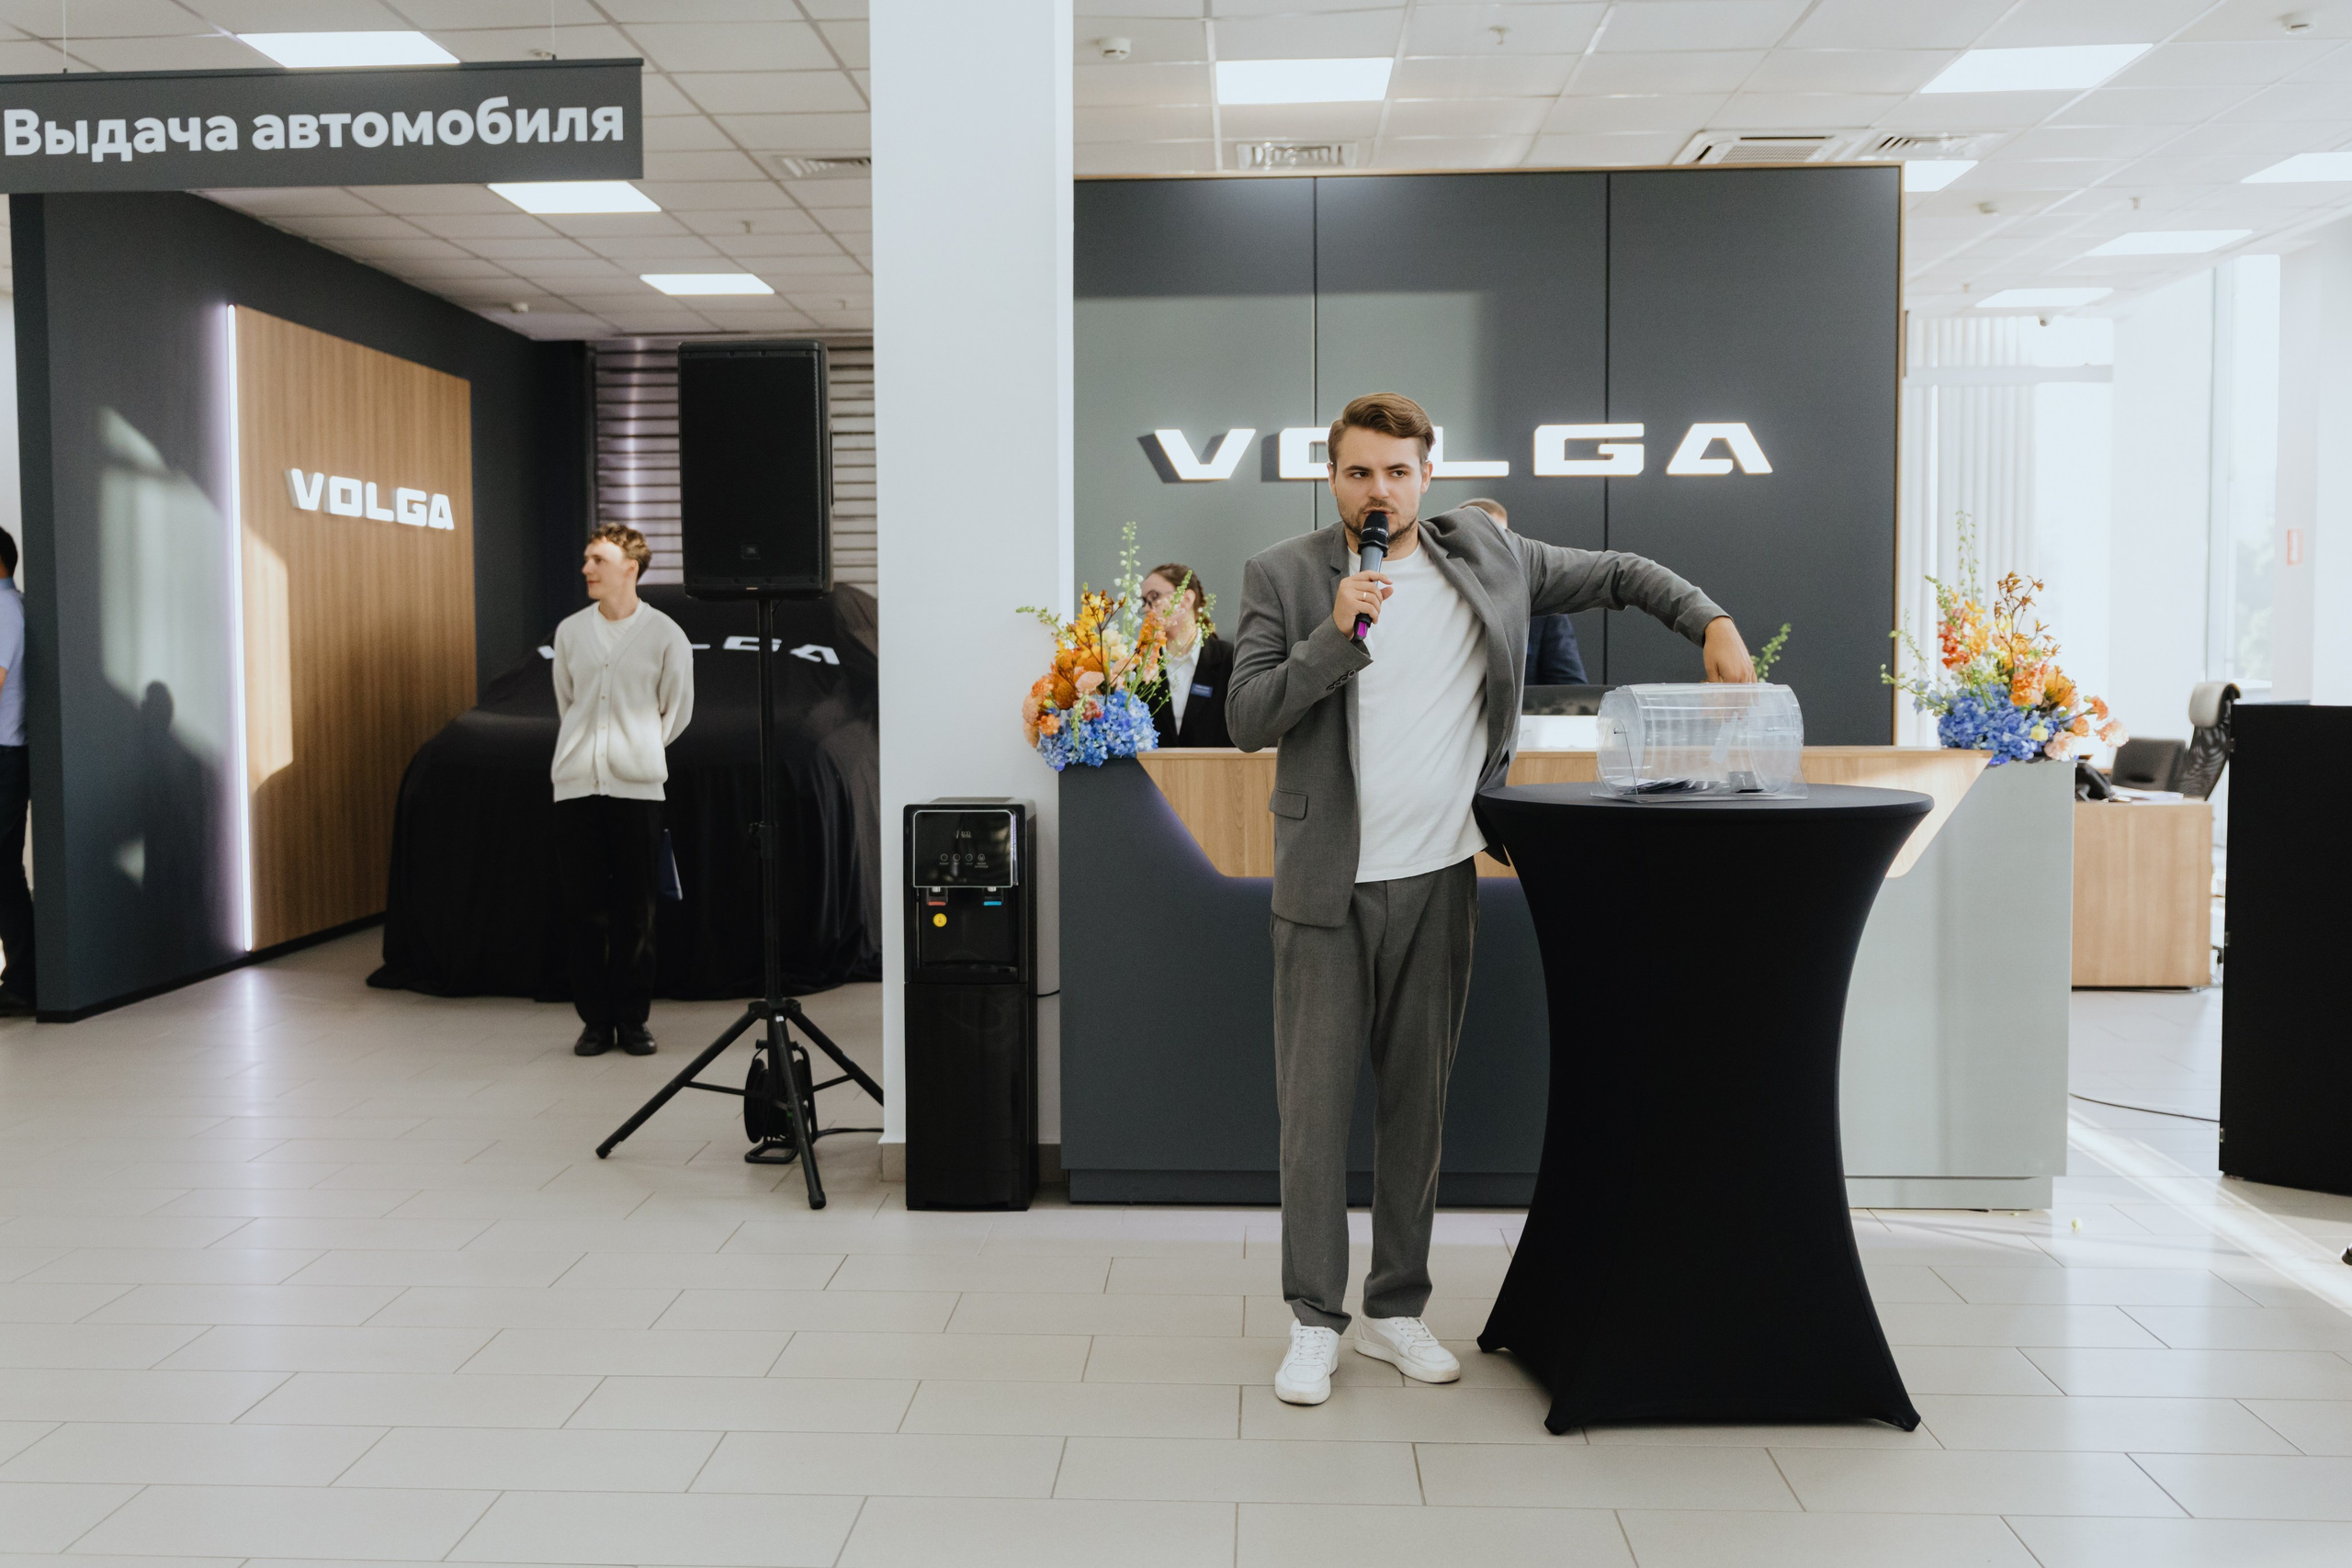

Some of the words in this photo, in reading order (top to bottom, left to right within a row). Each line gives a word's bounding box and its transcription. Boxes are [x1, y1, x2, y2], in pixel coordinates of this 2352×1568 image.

[4, 108, 239, 163] Выдача
[252, 96, 624, 151] автомобиля
[289, 467, 455, 531] VOLGA
